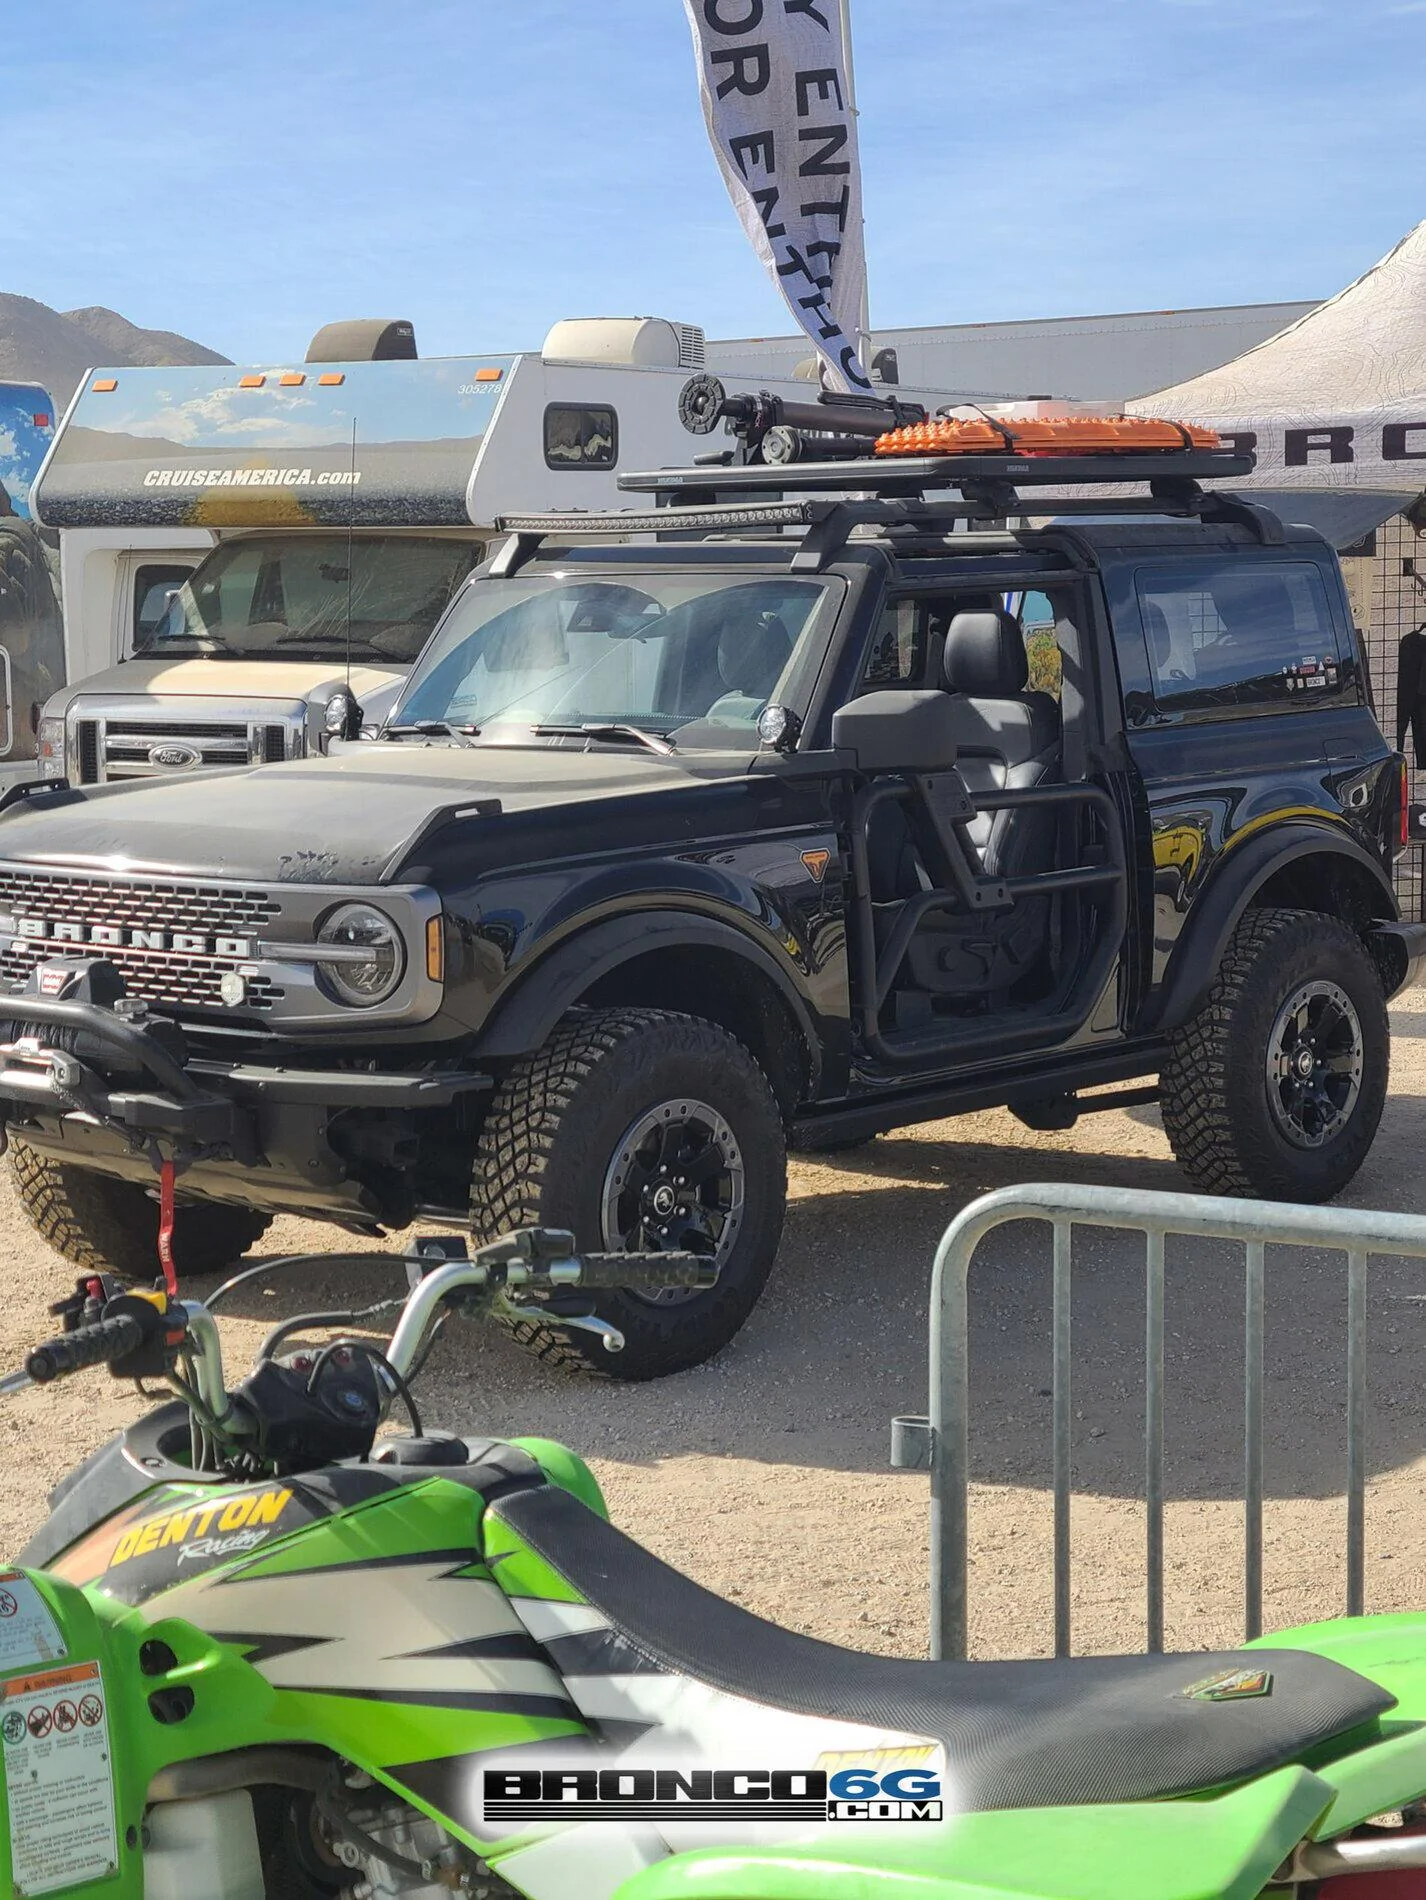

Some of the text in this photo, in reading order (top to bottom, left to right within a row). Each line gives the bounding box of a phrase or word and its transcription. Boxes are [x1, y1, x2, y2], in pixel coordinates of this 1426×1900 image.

[457, 383, 502, 394] 305278
[143, 468, 361, 486] CRUISEAMERICA.com
[160, 749, 183, 763] Ford
[18, 917, 250, 957] BRONCO
[109, 1488, 294, 1568] DENTON
[177, 1529, 270, 1567] Racing
